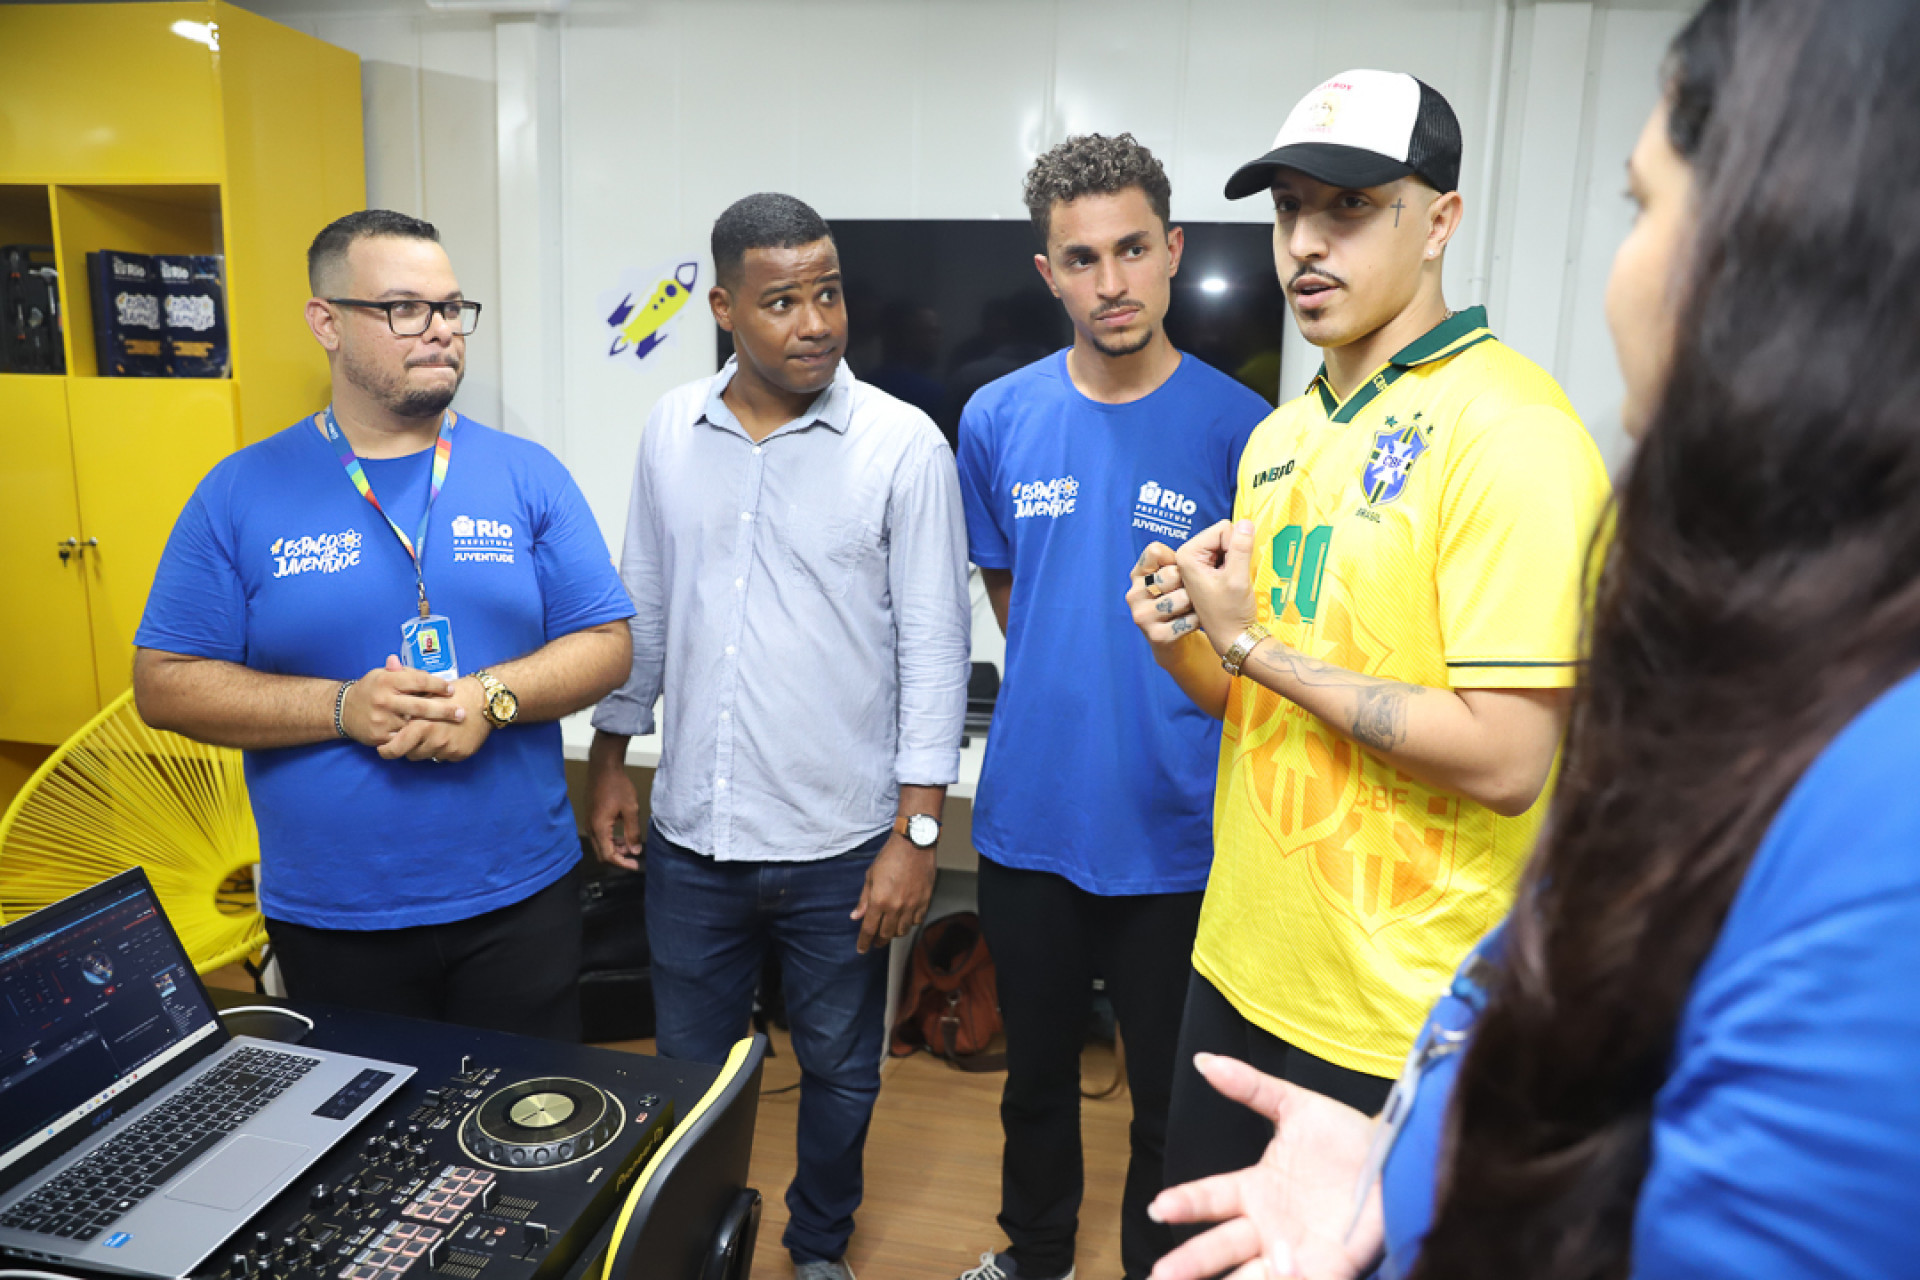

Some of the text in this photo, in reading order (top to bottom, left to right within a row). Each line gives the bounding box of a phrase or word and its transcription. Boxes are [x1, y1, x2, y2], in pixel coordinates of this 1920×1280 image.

[1160, 488, 1197, 516] Rio
[475, 518, 513, 539] Rio
[1131, 517, 1189, 541] JUVENTUDE
[273, 551, 360, 578] JUVENTUDE
[454, 552, 514, 564] JUVENTUDE
[1270, 524, 1335, 625] 90
[1354, 781, 1409, 815] CBF
